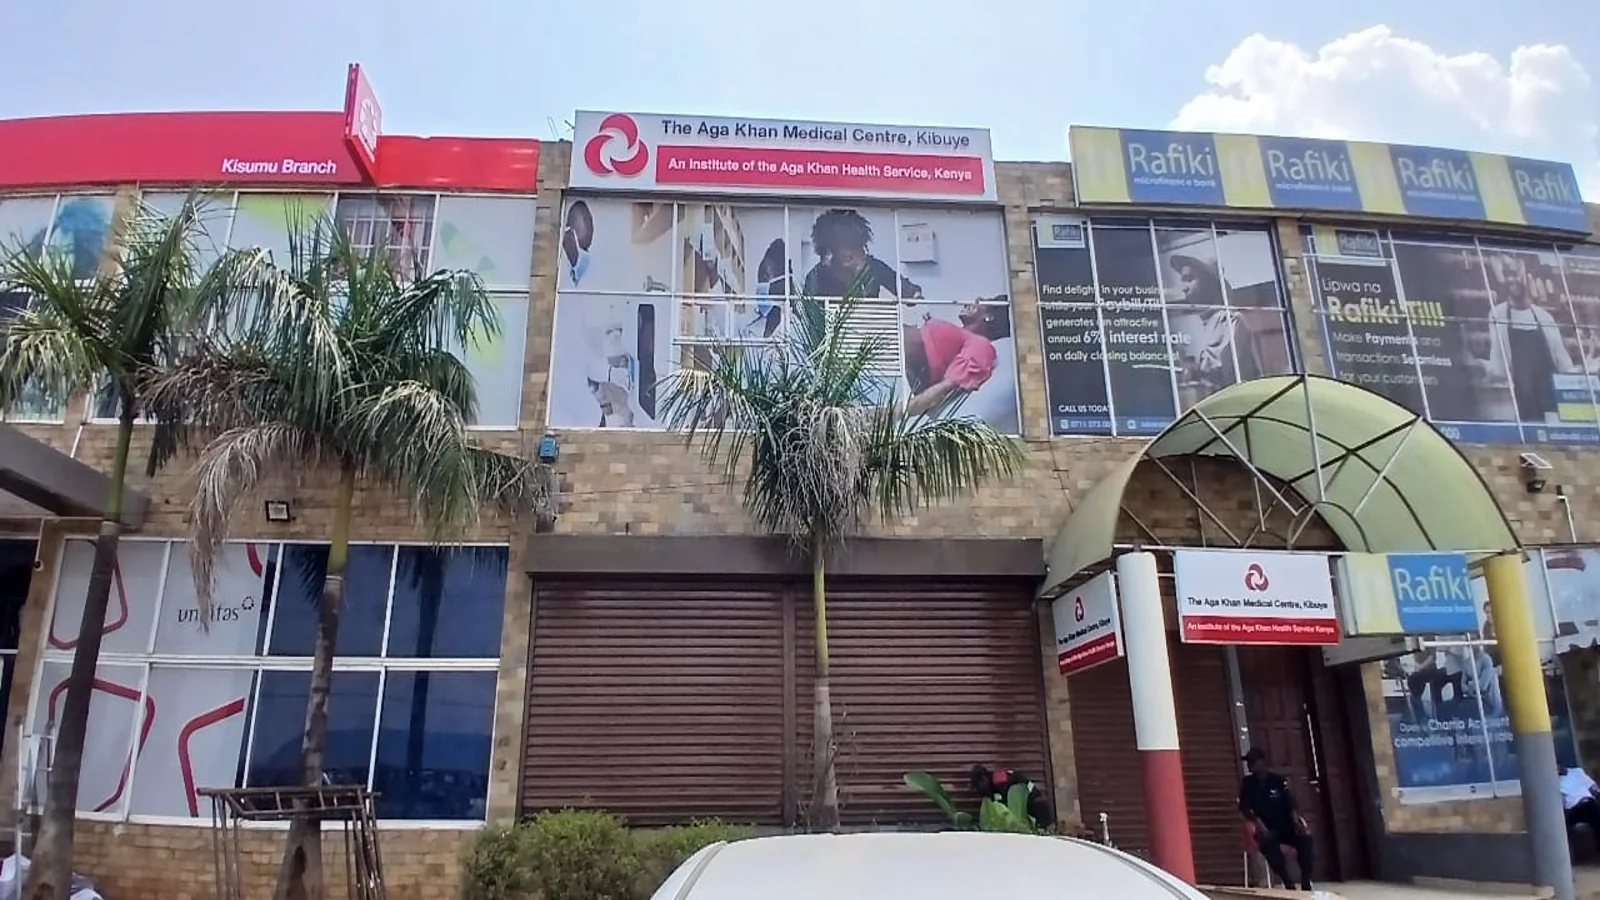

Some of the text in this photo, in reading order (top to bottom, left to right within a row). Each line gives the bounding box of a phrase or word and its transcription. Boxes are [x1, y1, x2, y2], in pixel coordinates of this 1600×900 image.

[662, 119, 970, 149] The Aga Khan Medical Centre, Kibuye
[221, 158, 337, 174] Kisumu Branch
[1127, 142, 1216, 177] Rafiki
[1267, 149, 1351, 182] Rafiki
[667, 157, 972, 182] An Institute of the Aga Khan Health Service, Kenya
[1397, 157, 1475, 191] Rafiki
[1042, 284, 1062, 295] Find
[1065, 284, 1095, 296] deligh
[1101, 284, 1110, 294] in
[1112, 286, 1133, 296] your
[1321, 278, 1382, 294] Lipwa na
[1326, 296, 1399, 325] Rafiki
[1046, 317, 1094, 329] generates
[1114, 317, 1159, 327] attractive
[1047, 333, 1081, 344] annual
[1109, 330, 1158, 345] interest
[1365, 332, 1418, 346] Paymens
[1050, 352, 1062, 360] on
[1065, 351, 1088, 362] daily
[1059, 404, 1077, 413] CALL
[1392, 564, 1472, 601] Rafiki
[1187, 596, 1202, 607] The
[1204, 598, 1220, 608] Aga
[1221, 598, 1241, 608] Khan
[1243, 598, 1273, 608] Medical
[1304, 600, 1328, 611] Kibuye
[178, 602, 240, 623] unitas
